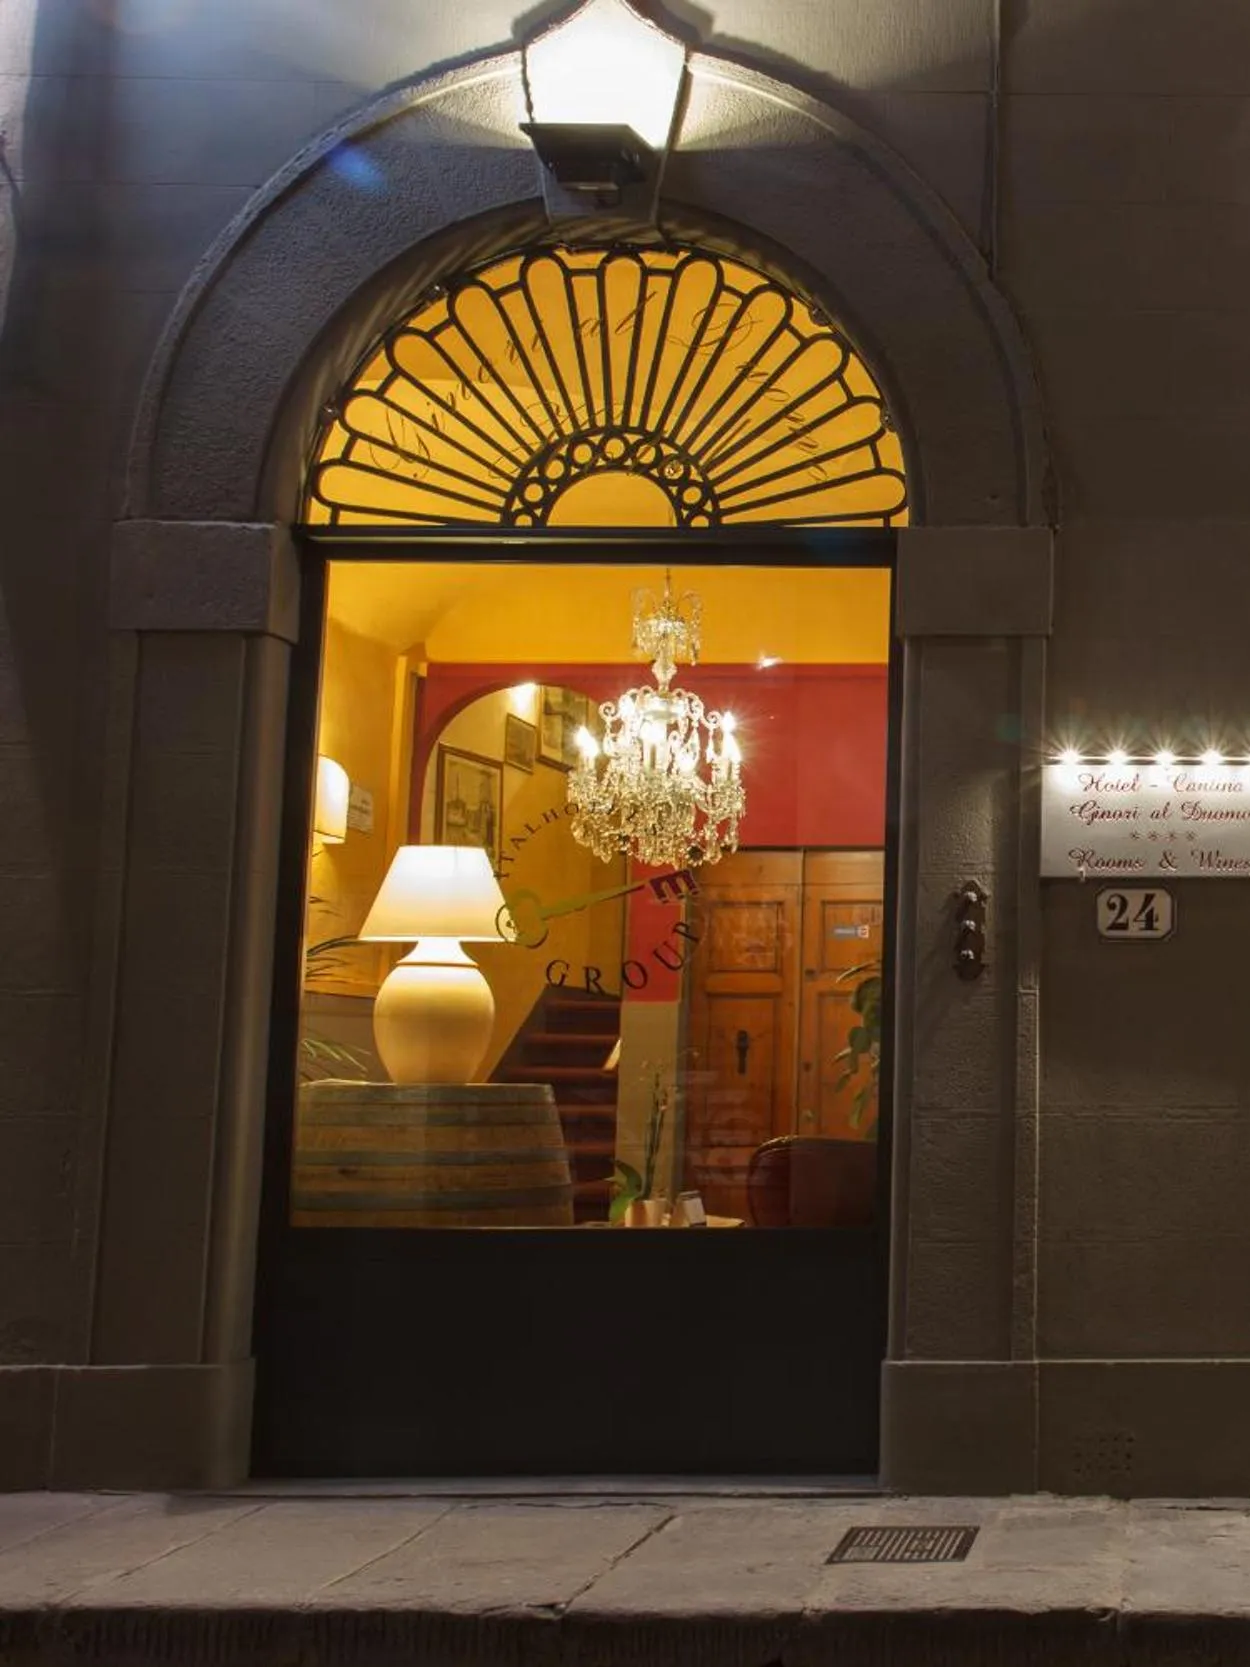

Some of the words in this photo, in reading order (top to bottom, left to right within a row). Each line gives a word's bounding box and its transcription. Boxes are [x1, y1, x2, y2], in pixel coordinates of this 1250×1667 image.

[1077, 773, 1139, 793] Hotel
[1069, 800, 1139, 825] Ginori
[1150, 801, 1171, 821] al
[1068, 847, 1145, 870] Rooms
[1158, 850, 1179, 869] &
[1106, 893, 1159, 931] 24
[546, 921, 700, 996] GROUP
